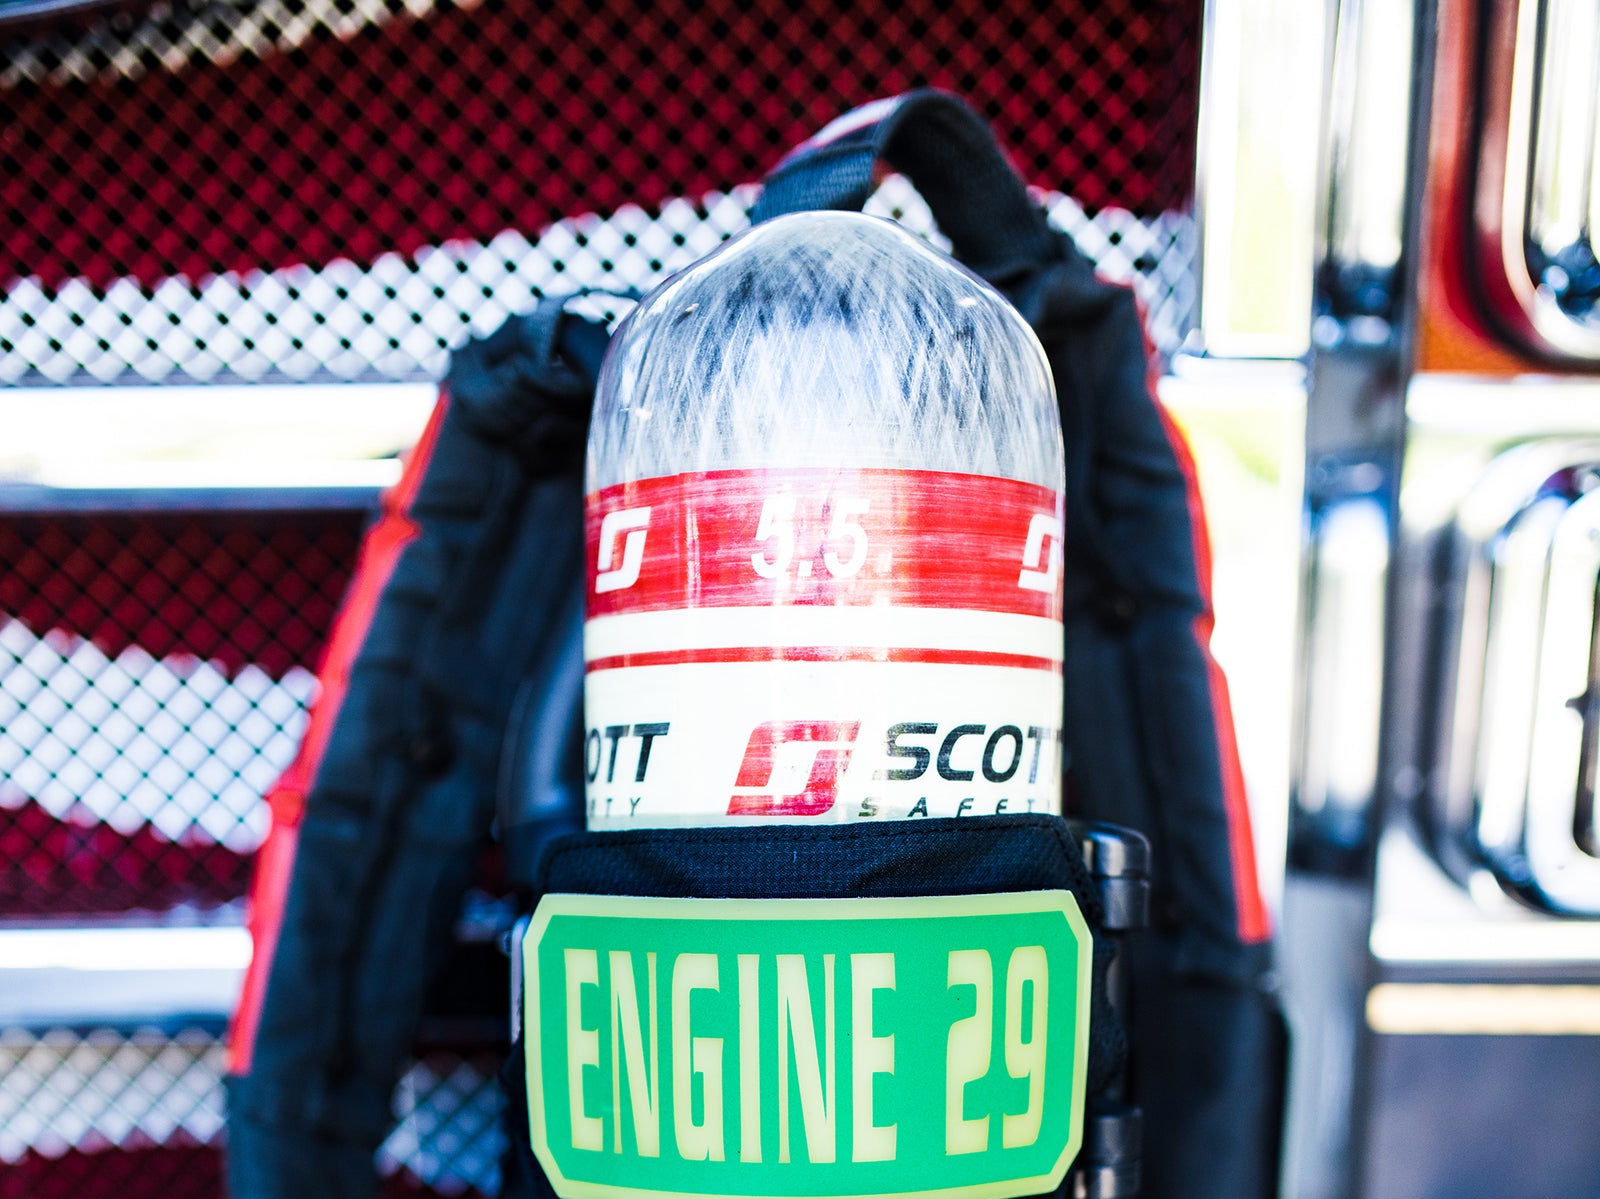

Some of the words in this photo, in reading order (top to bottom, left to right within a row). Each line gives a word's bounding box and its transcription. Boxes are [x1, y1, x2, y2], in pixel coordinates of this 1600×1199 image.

[750, 498, 871, 578] 5.5
[872, 722, 1062, 783] SCOT
[563, 948, 898, 1164] ENGINE
[945, 945, 1049, 1156] 29
